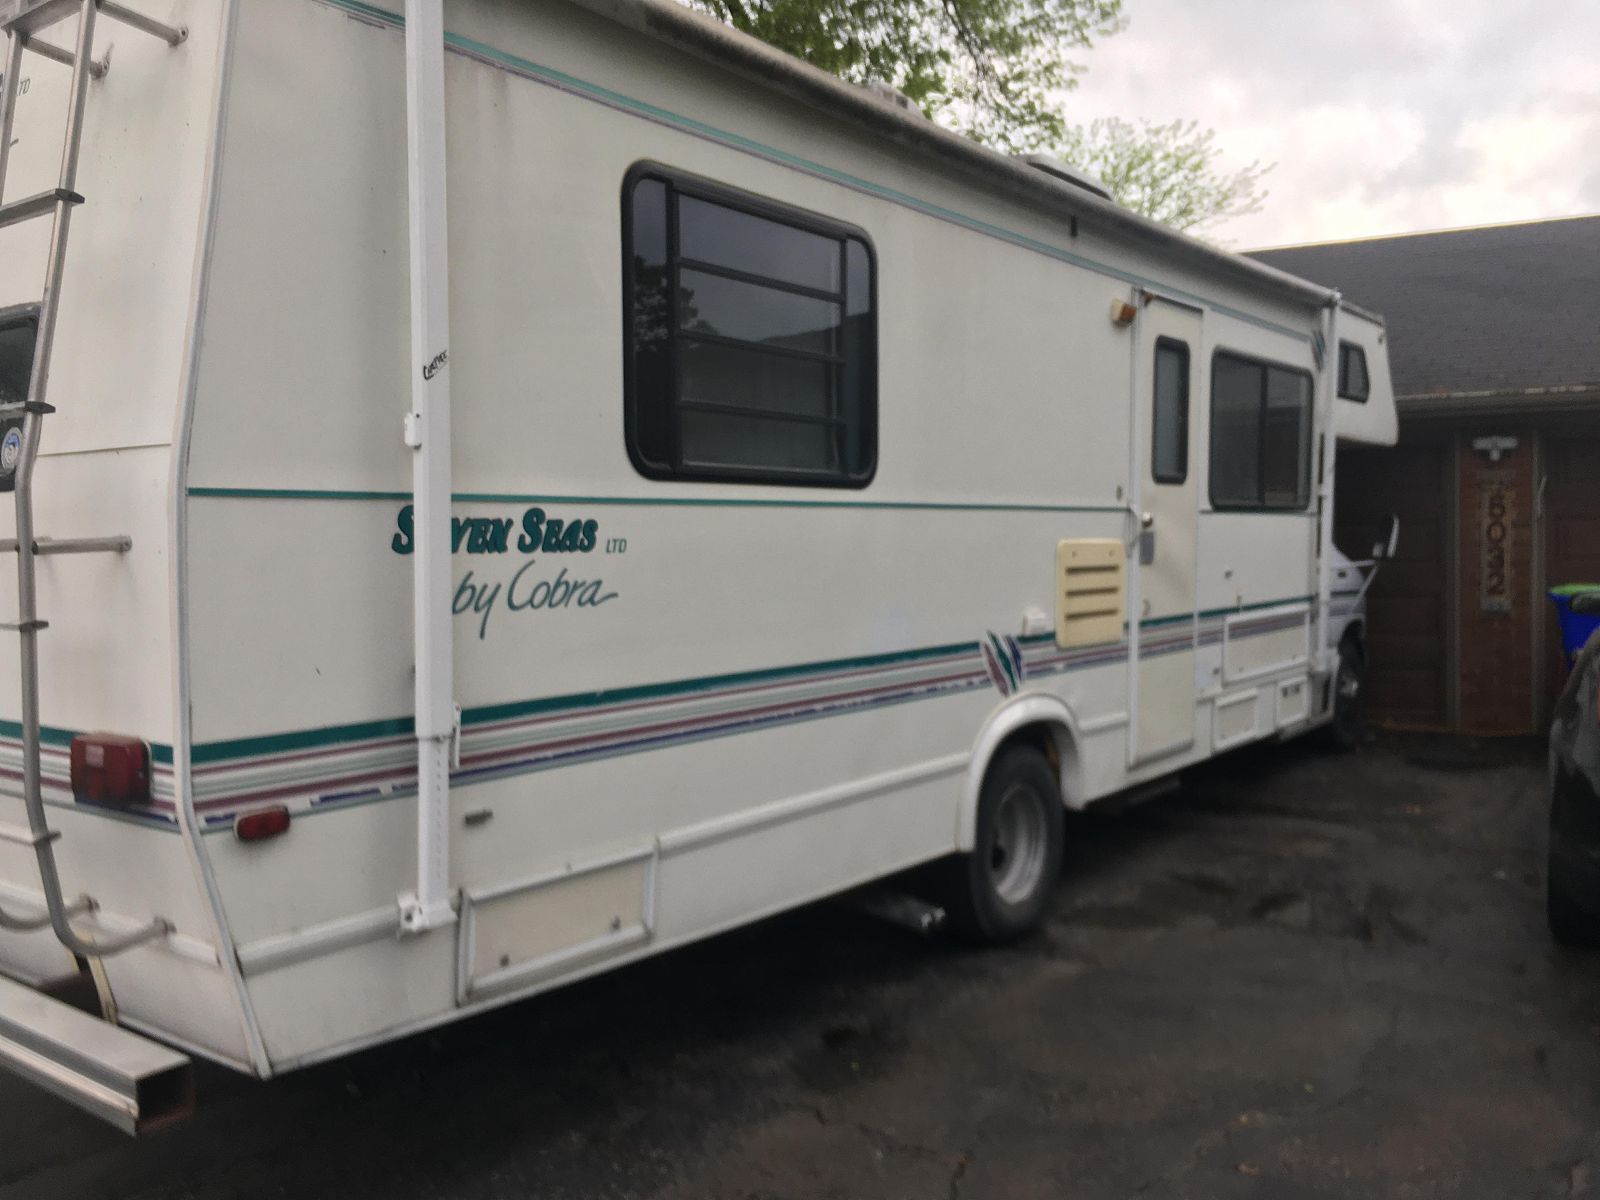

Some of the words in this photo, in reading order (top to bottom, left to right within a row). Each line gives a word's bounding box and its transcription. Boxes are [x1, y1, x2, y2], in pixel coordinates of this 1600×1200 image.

[17, 78, 31, 96] TD
[392, 505, 513, 554] SVEN
[606, 538, 627, 553] LTD
[452, 571, 501, 640] by
[507, 559, 619, 611] Cobra
